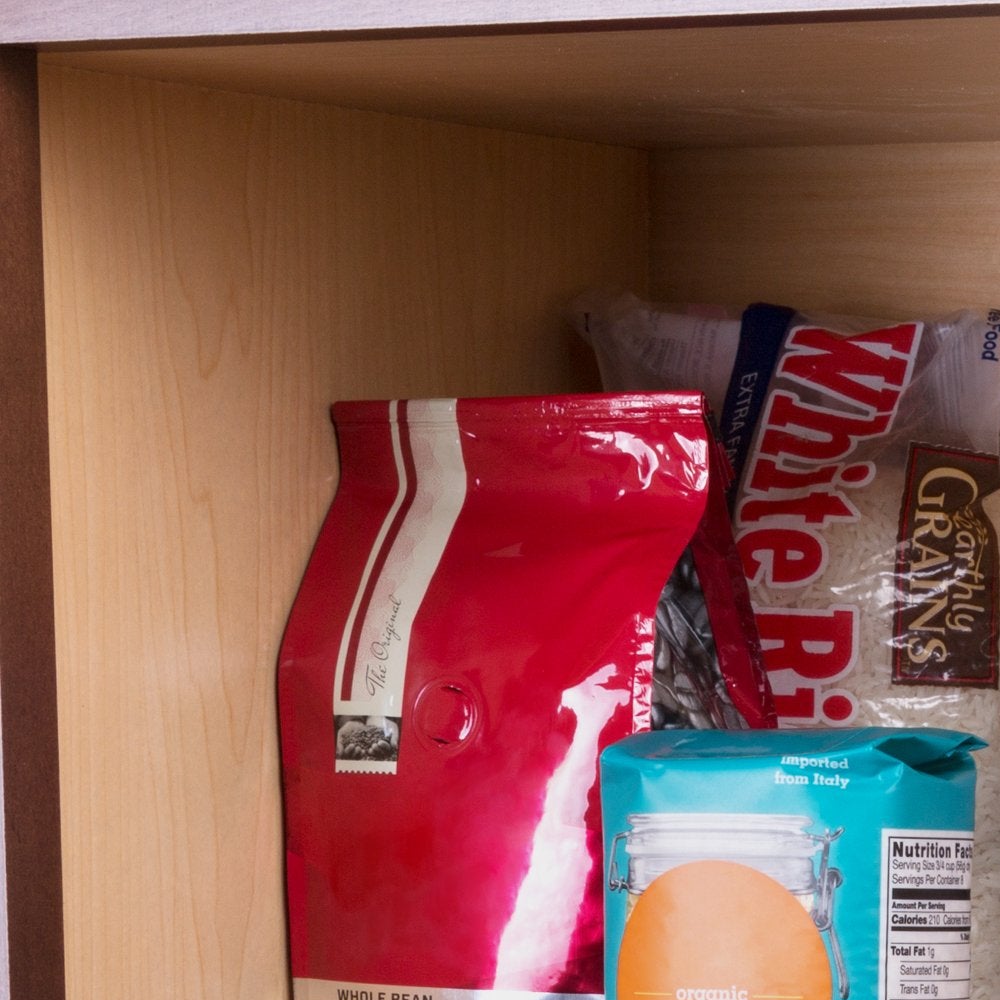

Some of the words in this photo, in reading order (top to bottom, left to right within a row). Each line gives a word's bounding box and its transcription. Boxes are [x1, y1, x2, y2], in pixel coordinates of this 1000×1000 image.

[730, 371, 758, 432] EXTRA
[735, 322, 923, 590] White
[906, 466, 979, 665] GRAINS
[945, 510, 986, 633] Earthly
[370, 593, 402, 661] Original
[365, 664, 387, 696] The
[780, 755, 849, 769] imported
[774, 771, 809, 785] from
[813, 773, 850, 789] Italy
[892, 841, 951, 858] Nutrition
[892, 859, 921, 872] Serving
[922, 859, 935, 870] Size
[946, 862, 955, 871] cup
[892, 873, 924, 887] Servings
[926, 874, 936, 884] Per
[937, 874, 960, 885] Container
[891, 902, 916, 910] Amount
[918, 902, 927, 910] Per
[928, 903, 945, 911] Serving
[891, 914, 927, 925] Calories
[929, 915, 940, 925] 210
[890, 946, 911, 956] Total
[913, 945, 926, 956] Fat
[900, 964, 932, 976] Saturated
[933, 964, 942, 975] Fat
[943, 965, 949, 978] 0g
[900, 984, 918, 995] Trans
[920, 984, 930, 994] Fat
[931, 984, 938, 997] 0g
